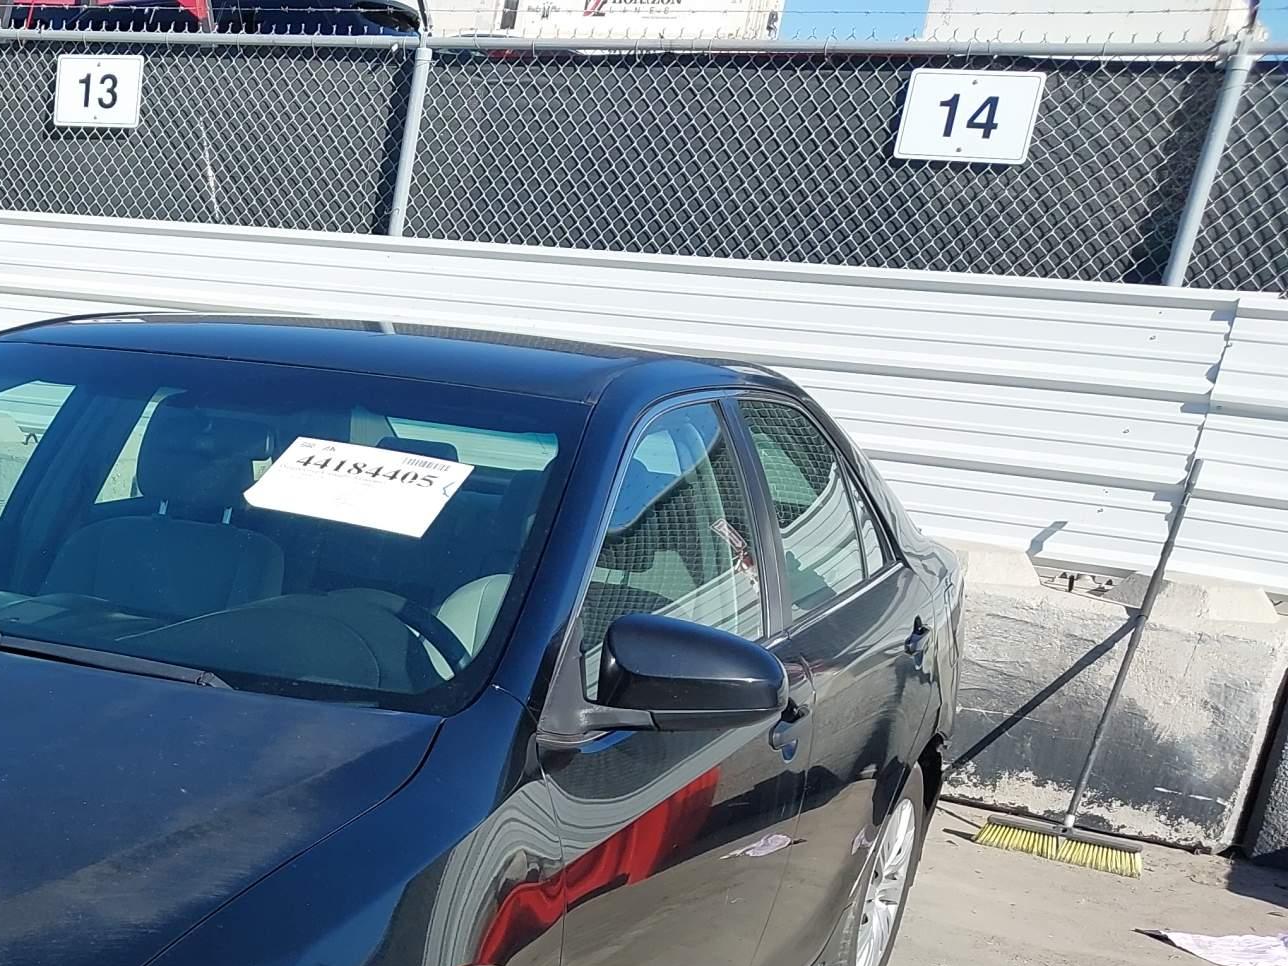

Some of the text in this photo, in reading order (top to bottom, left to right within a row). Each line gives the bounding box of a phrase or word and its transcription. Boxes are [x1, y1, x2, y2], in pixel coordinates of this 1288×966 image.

[78, 73, 118, 109] 13
[939, 93, 1000, 139] 14
[296, 455, 440, 488] 44184405
